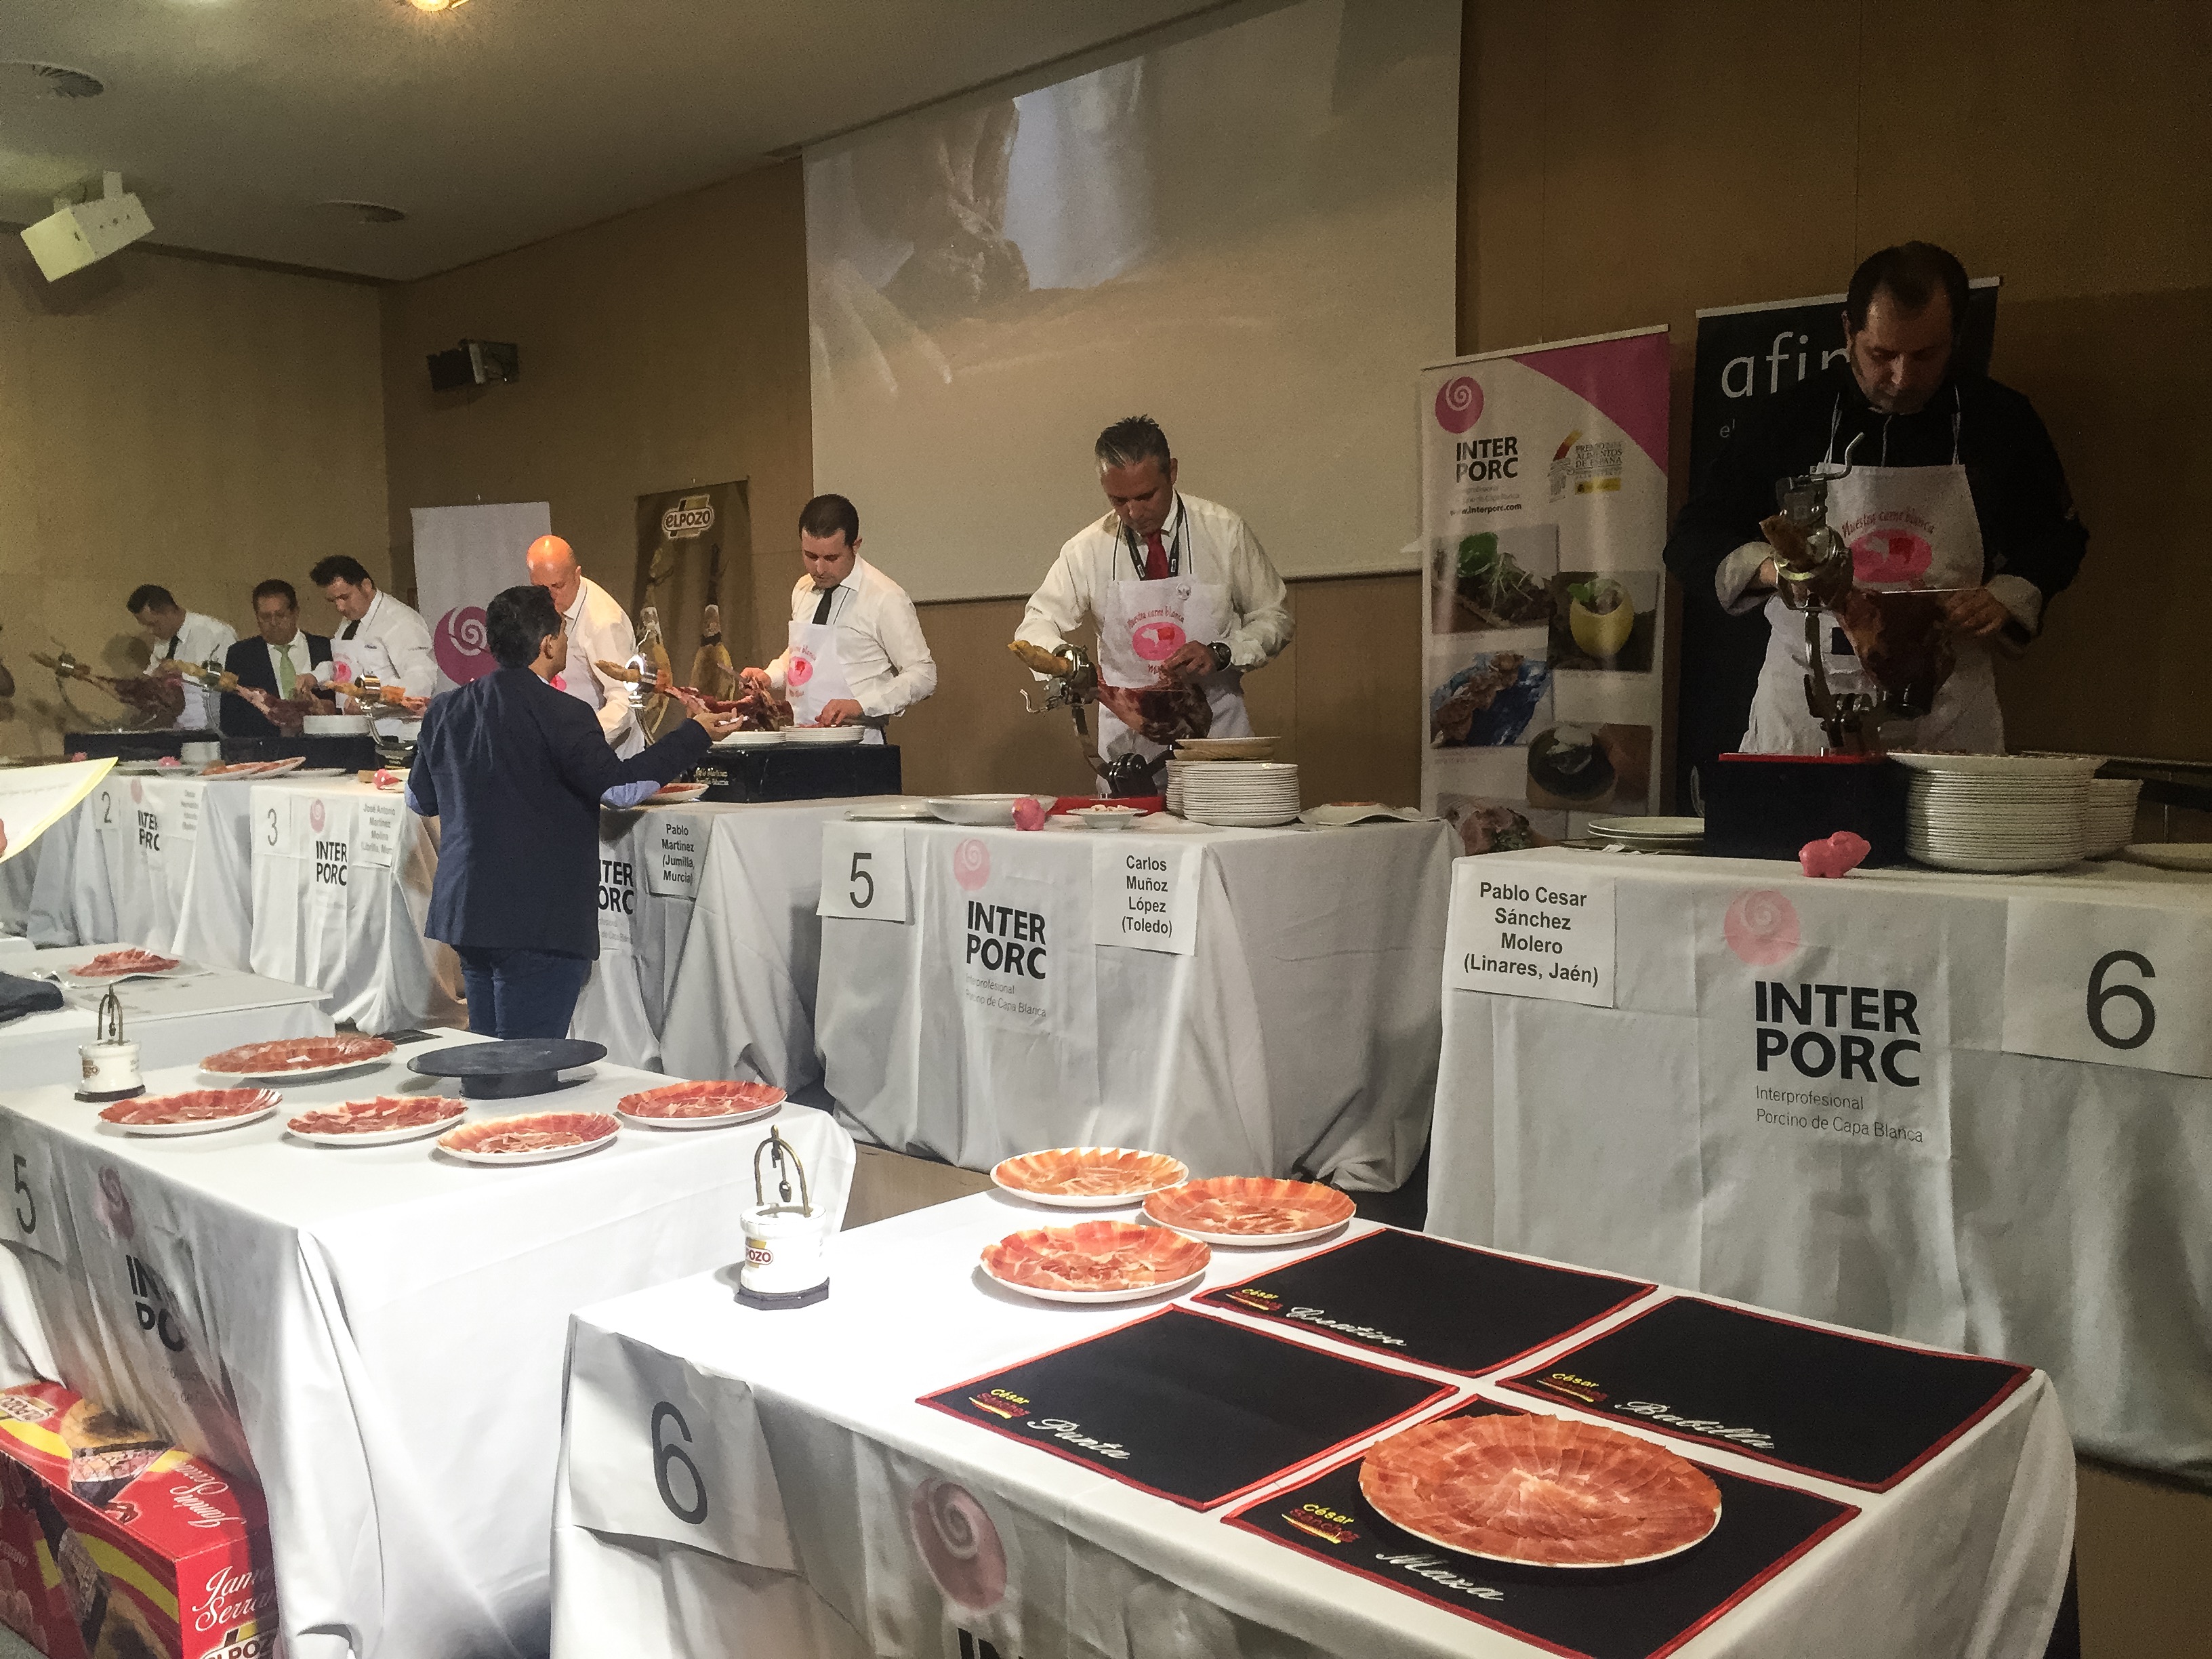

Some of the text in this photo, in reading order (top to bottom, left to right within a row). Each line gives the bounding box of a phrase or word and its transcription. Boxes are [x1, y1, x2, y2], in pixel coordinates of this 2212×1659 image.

[1456, 436, 1518, 462] INTER
[1456, 457, 1518, 483] PORC
[1450, 504, 1522, 516] ww.interporc.com
[101, 791, 112, 823] 2
[267, 808, 278, 846] 3
[665, 823, 689, 836] Pablo
[315, 840, 348, 863] INTER
[1126, 855, 1168, 872] Carlos
[316, 861, 348, 886] PORC
[663, 869, 693, 886] Murcia)
[849, 852, 874, 909] 5
[1126, 875, 1168, 893] Muñoz
[1128, 896, 1167, 915] López
[1479, 881, 1587, 907] Pablo Cesar
[966, 900, 1046, 945] INTER
[1122, 916, 1173, 939] (Toledo)
[1494, 907, 1572, 930] Sánchez
[1500, 932, 1563, 954] Molero
[966, 933, 1047, 980] PORC
[1464, 953, 1599, 988] (Linares, Jaén)
[1018, 1002, 1046, 1017] Blanca
[1755, 980, 1921, 1036] INTER
[2087, 949, 2156, 1050] 6
[1755, 1027, 1921, 1088] PORC
[1756, 1084, 1864, 1111] Interprofesional
[1757, 1107, 1923, 1143] Porcino de Capa Blanca
[13, 1153, 37, 1234] 5
[651, 1400, 708, 1525] 6
